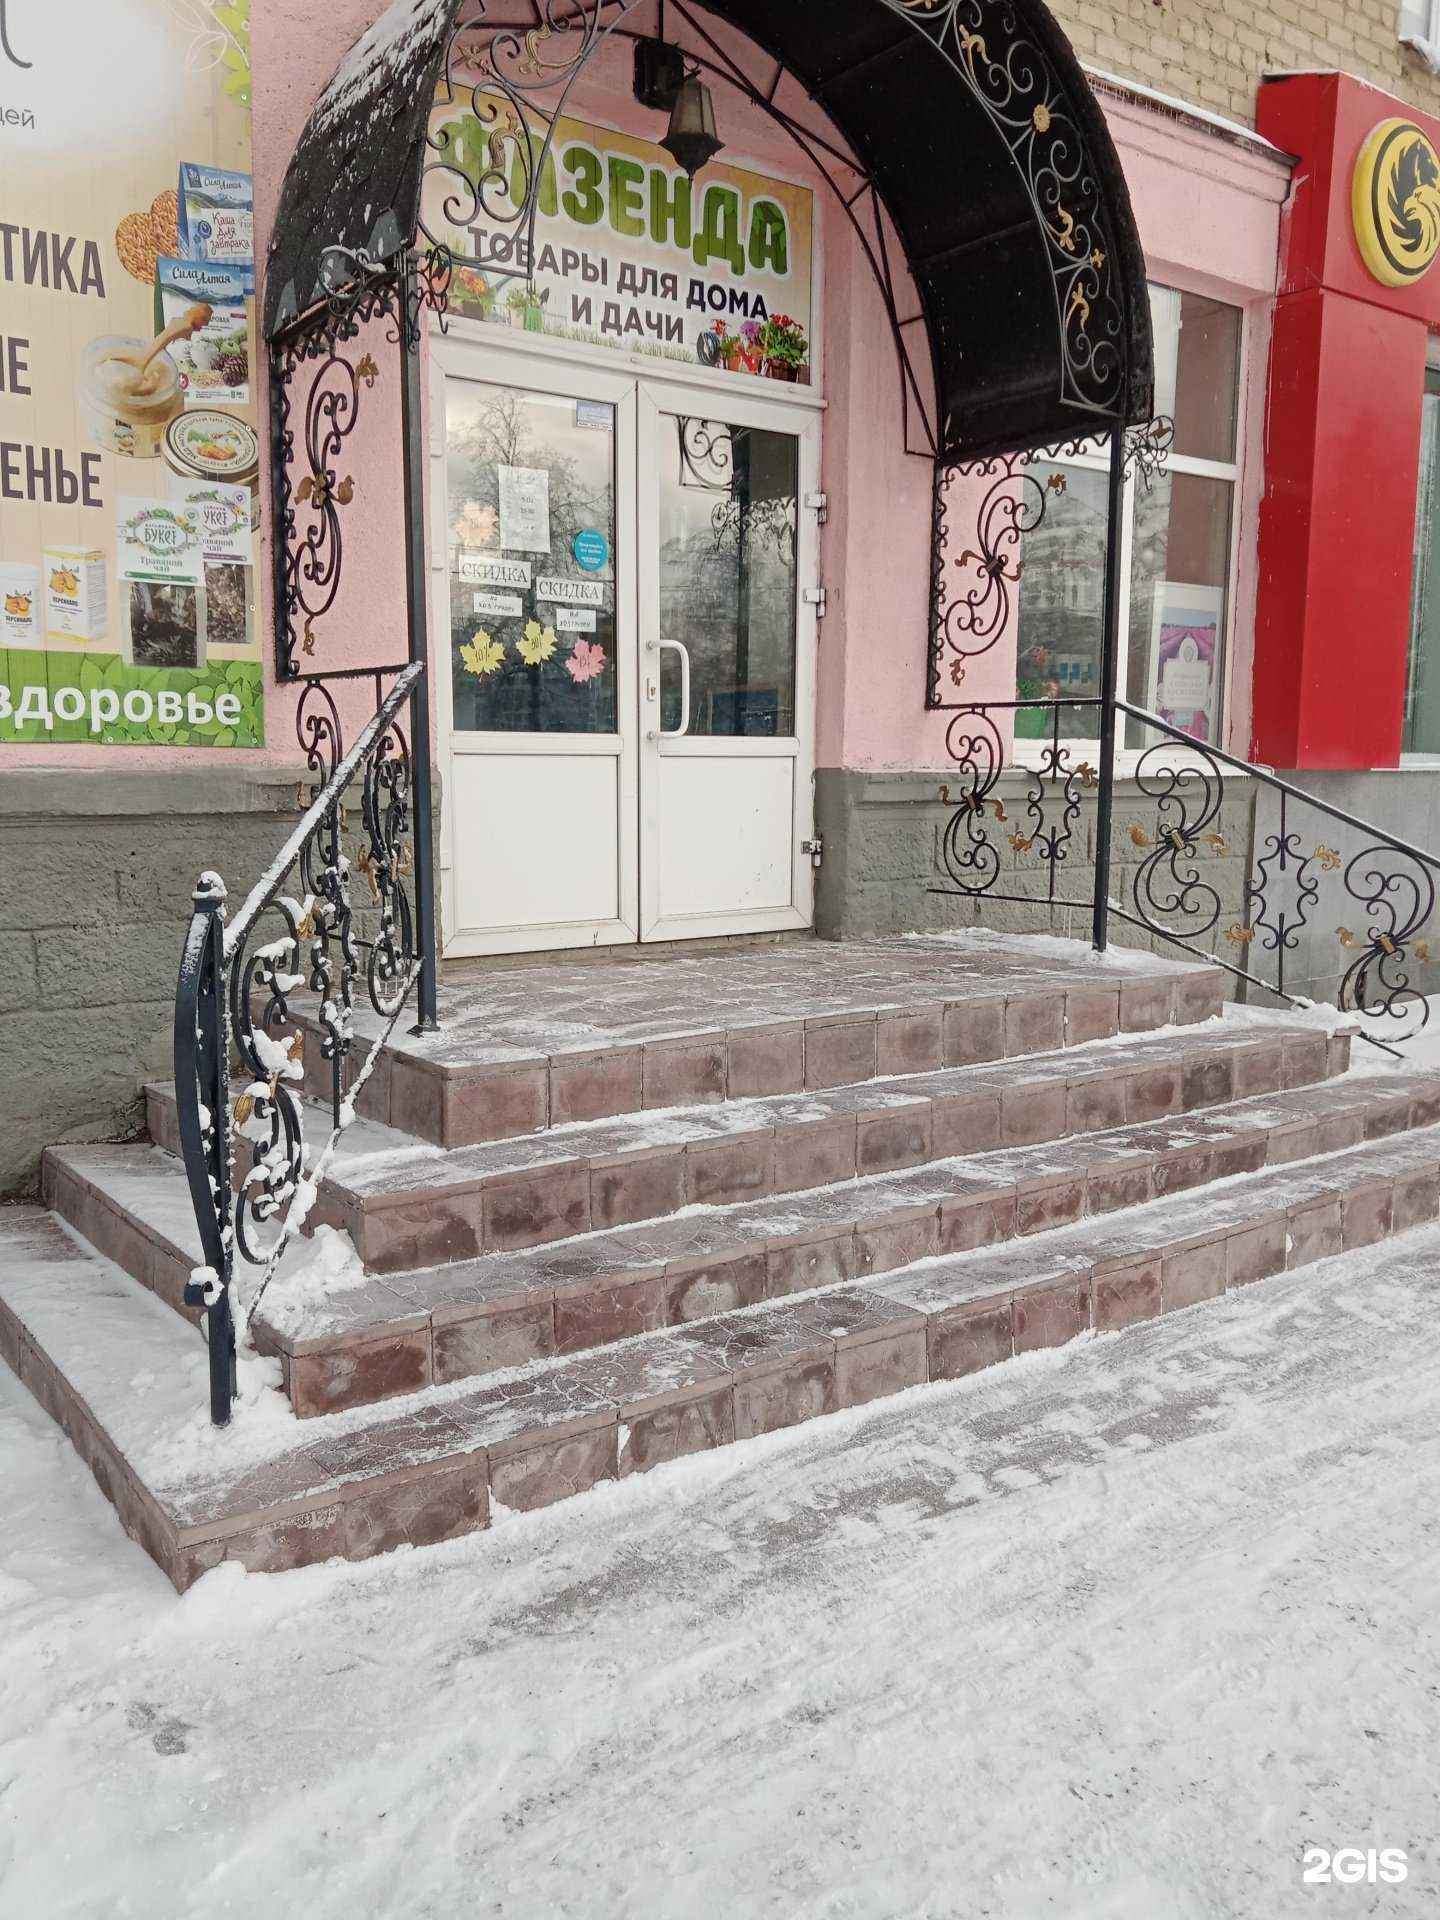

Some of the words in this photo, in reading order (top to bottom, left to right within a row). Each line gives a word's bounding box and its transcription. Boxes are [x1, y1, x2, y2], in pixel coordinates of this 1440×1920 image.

[438, 114, 788, 276] ФАЗЕНДА
[0, 223, 106, 298] ТИКА
[172, 267, 199, 281] Сила
[196, 271, 231, 285] Алтая
[467, 226, 608, 286] ТОВАРЫ
[616, 262, 678, 301] ДЛЯ
[686, 280, 768, 321] ДОМА
[571, 294, 592, 325] И
[601, 304, 684, 343] ДАЧИ
[0, 442, 104, 508] ЕНЬЕ
[462, 562, 528, 583] СКИДКА
[539, 581, 600, 600] СКИДКА
[0, 684, 242, 733] здоровье
